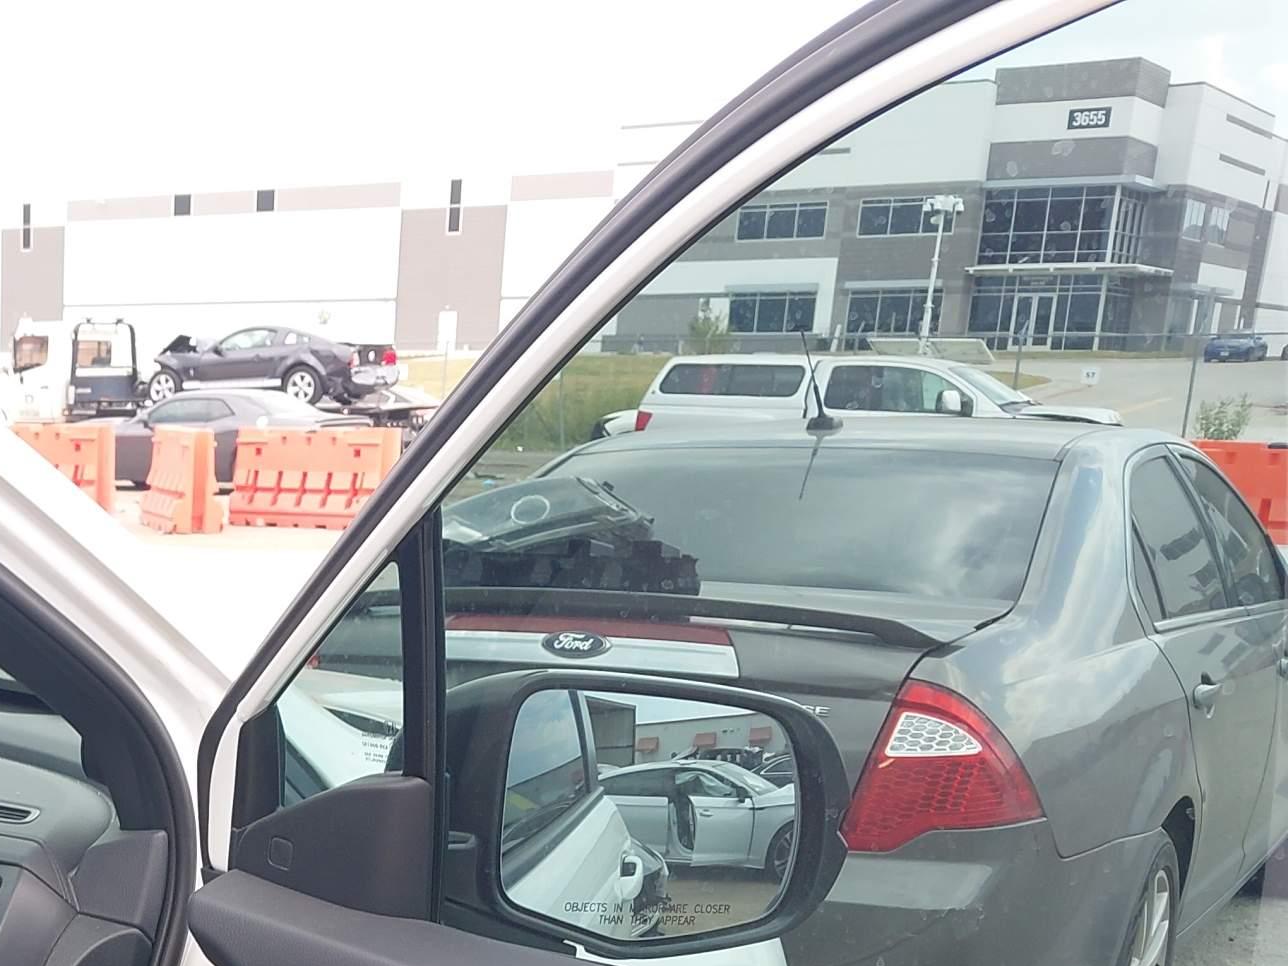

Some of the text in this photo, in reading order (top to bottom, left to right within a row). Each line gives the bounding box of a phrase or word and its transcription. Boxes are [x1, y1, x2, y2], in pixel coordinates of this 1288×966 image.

[1072, 110, 1107, 127] 3655
[553, 632, 594, 651] Ford
[564, 902, 731, 914] OBJECTS IN MROR ARE CLOSER
[599, 915, 696, 926] THAN THEY APPEAR
